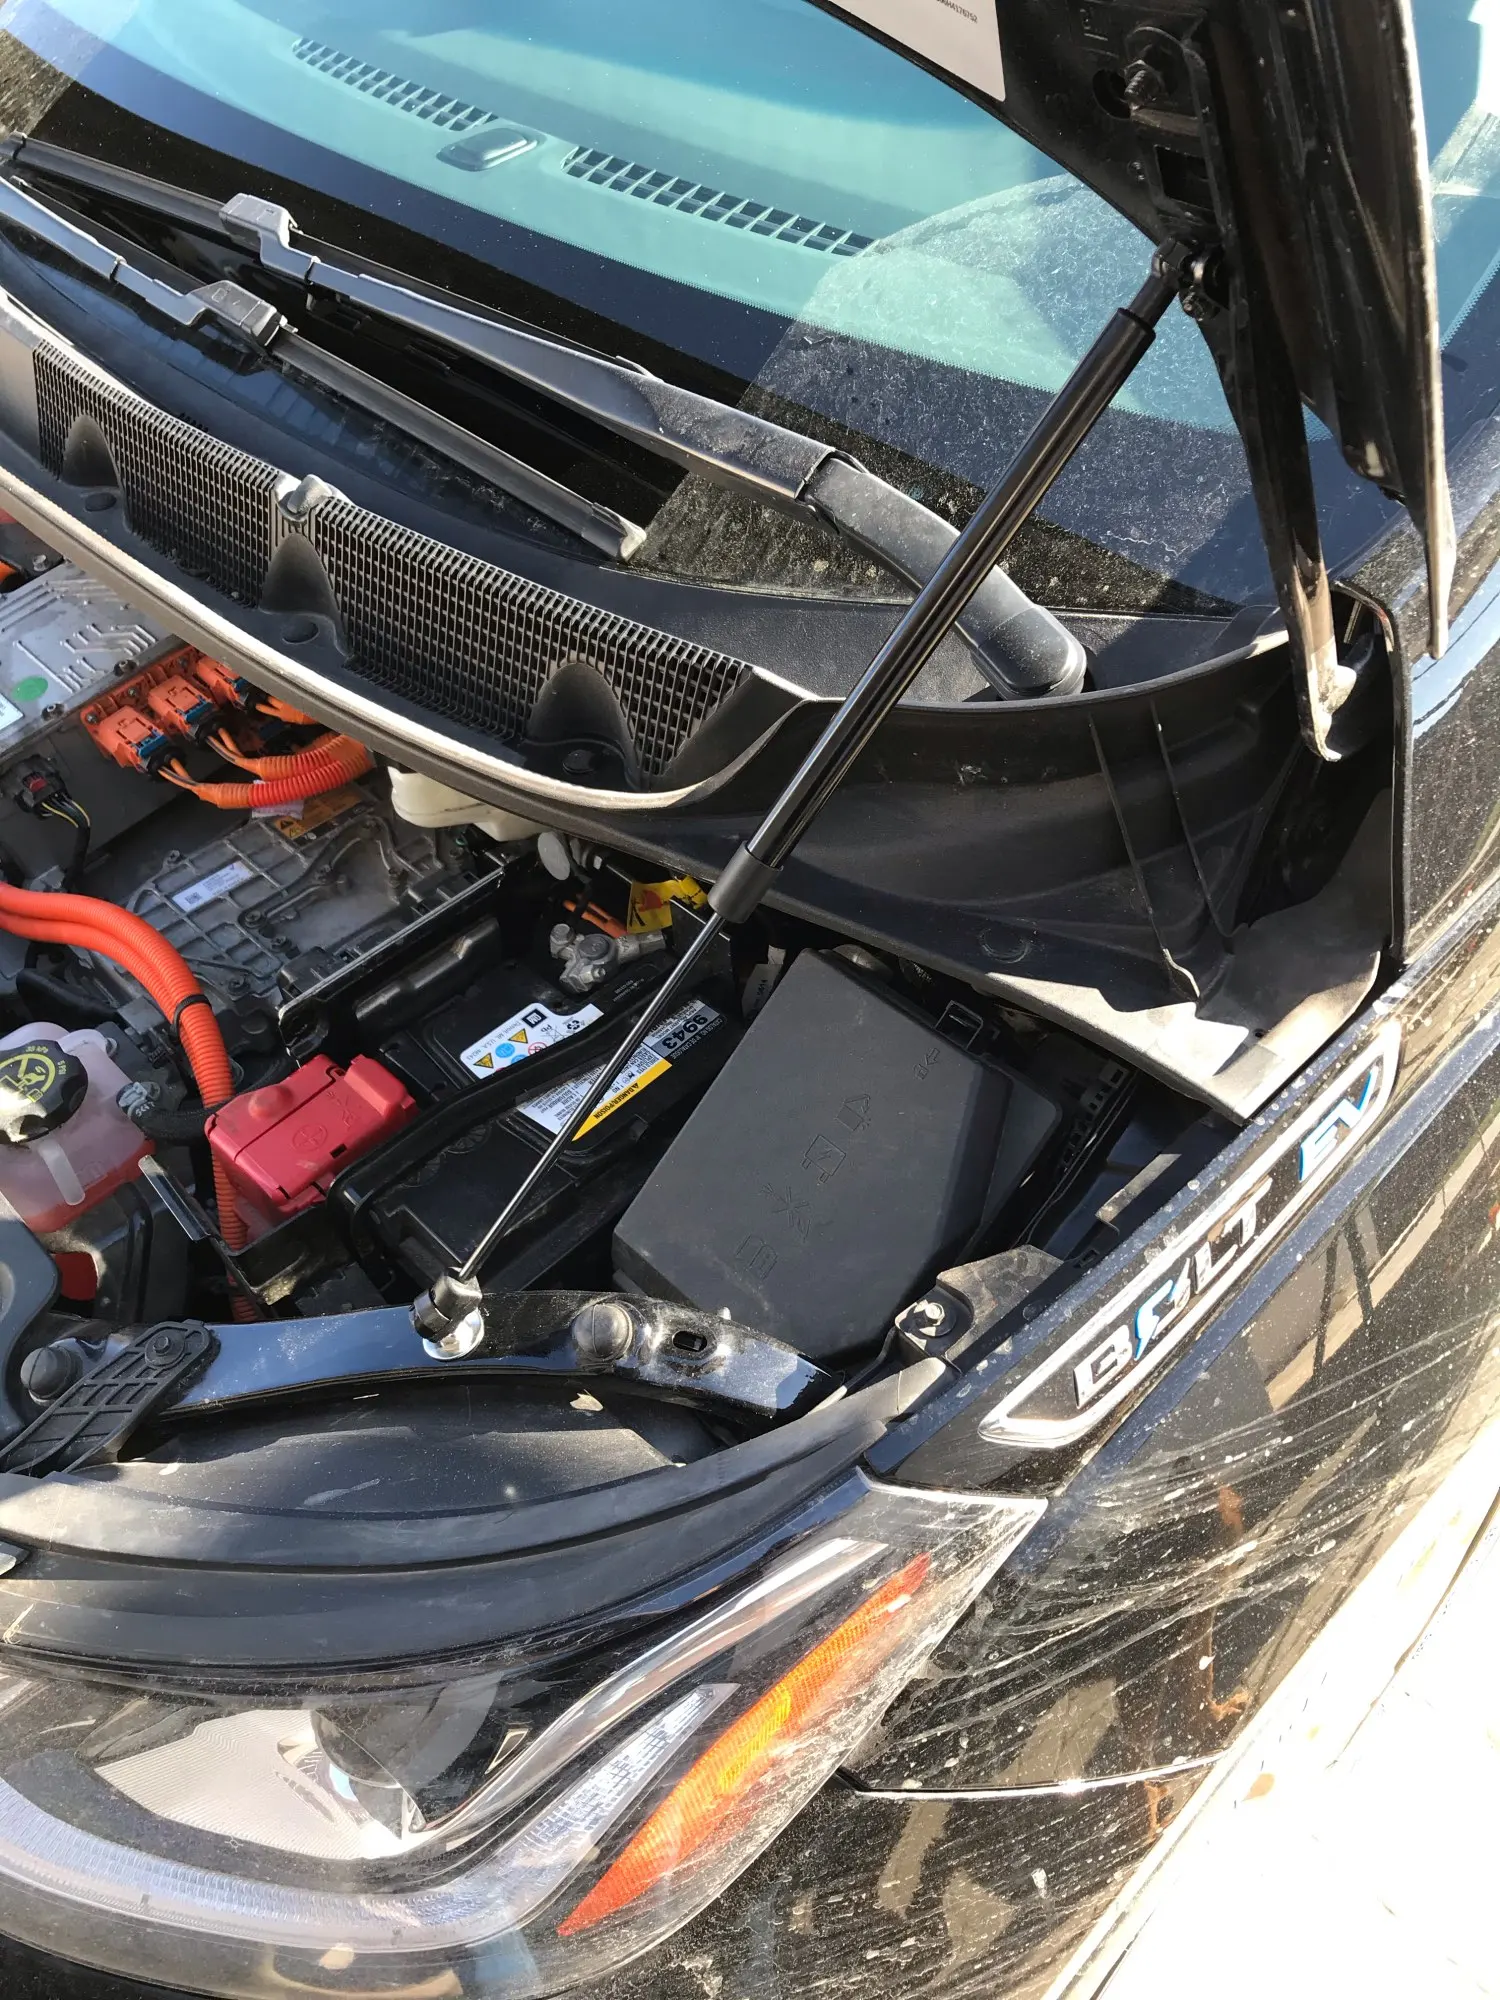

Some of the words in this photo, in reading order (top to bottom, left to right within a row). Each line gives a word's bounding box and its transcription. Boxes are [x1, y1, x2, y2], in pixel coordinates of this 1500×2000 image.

[659, 1013, 709, 1049] 9943
[592, 1086, 634, 1118] DANGER/POISON
[1073, 1177, 1273, 1408] BOLT
[1298, 1066, 1380, 1182] EV
